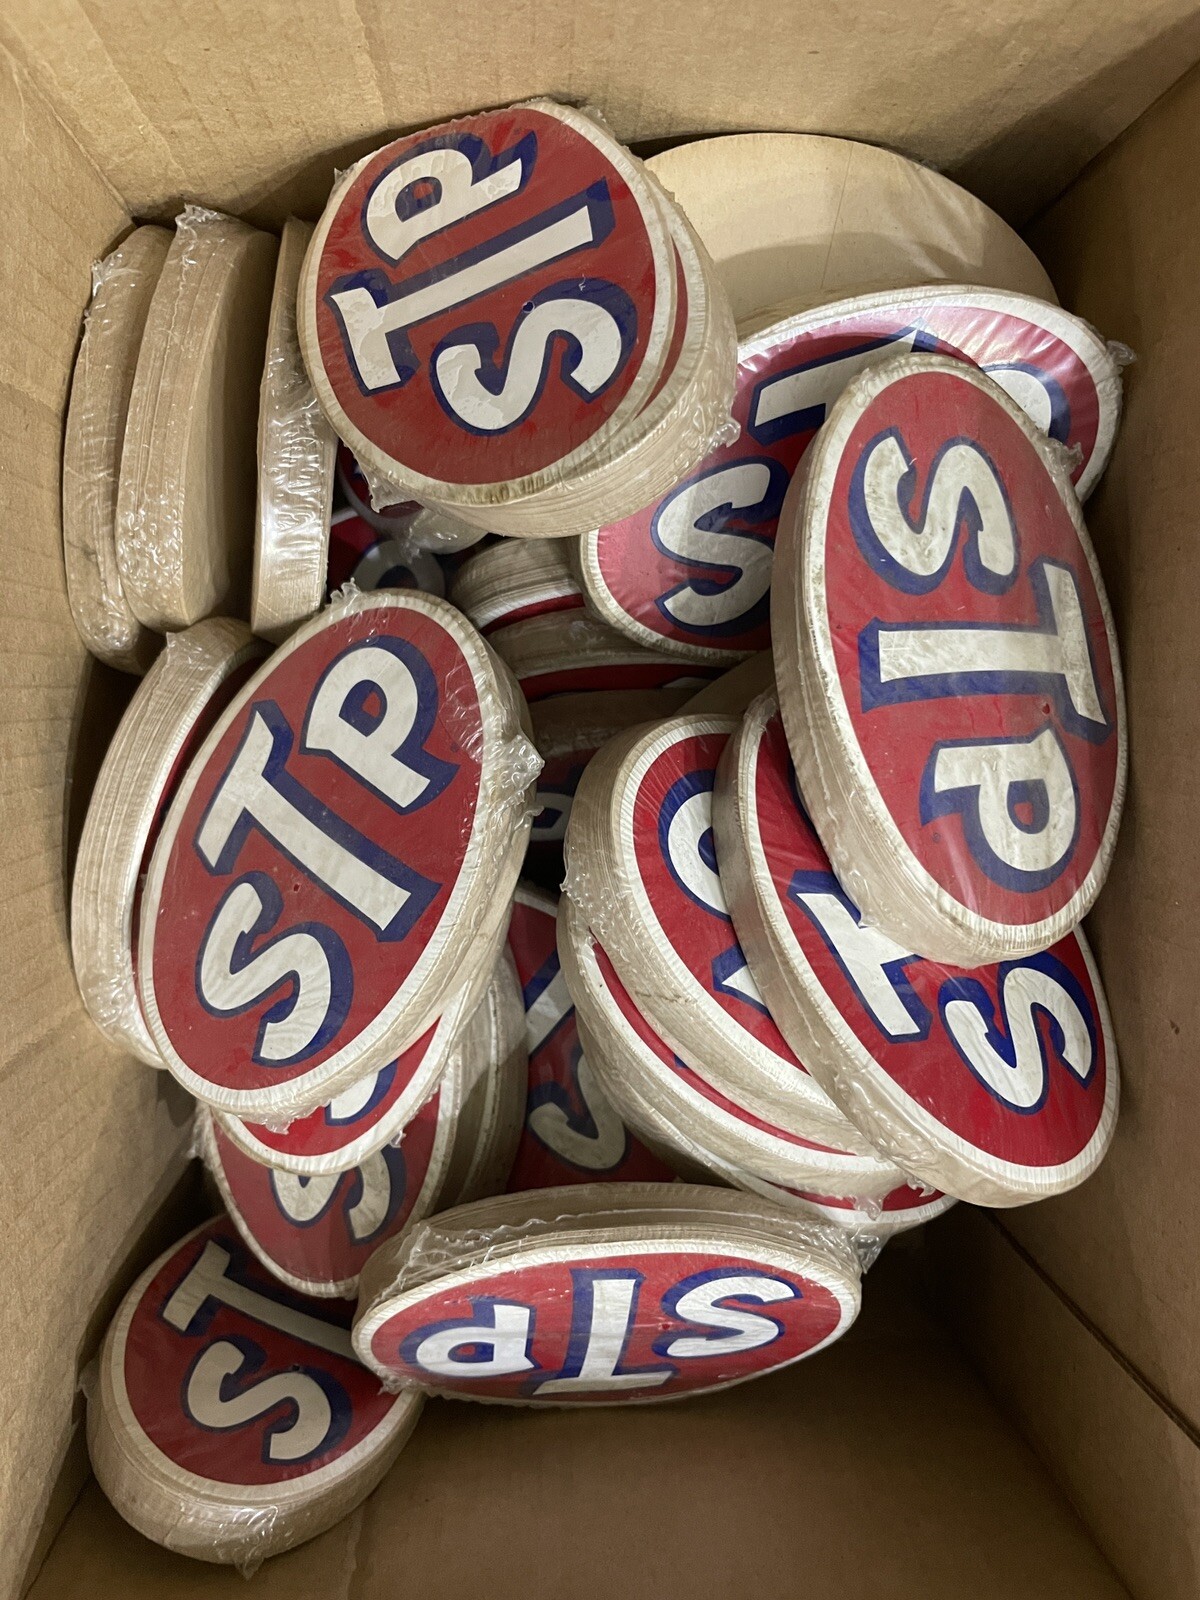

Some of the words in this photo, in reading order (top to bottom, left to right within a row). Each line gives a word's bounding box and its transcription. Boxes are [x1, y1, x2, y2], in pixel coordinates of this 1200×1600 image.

[330, 134, 636, 436] STP
[848, 426, 1112, 892] STP
[195, 636, 456, 1067] STP
[402, 1268, 802, 1396] STP
